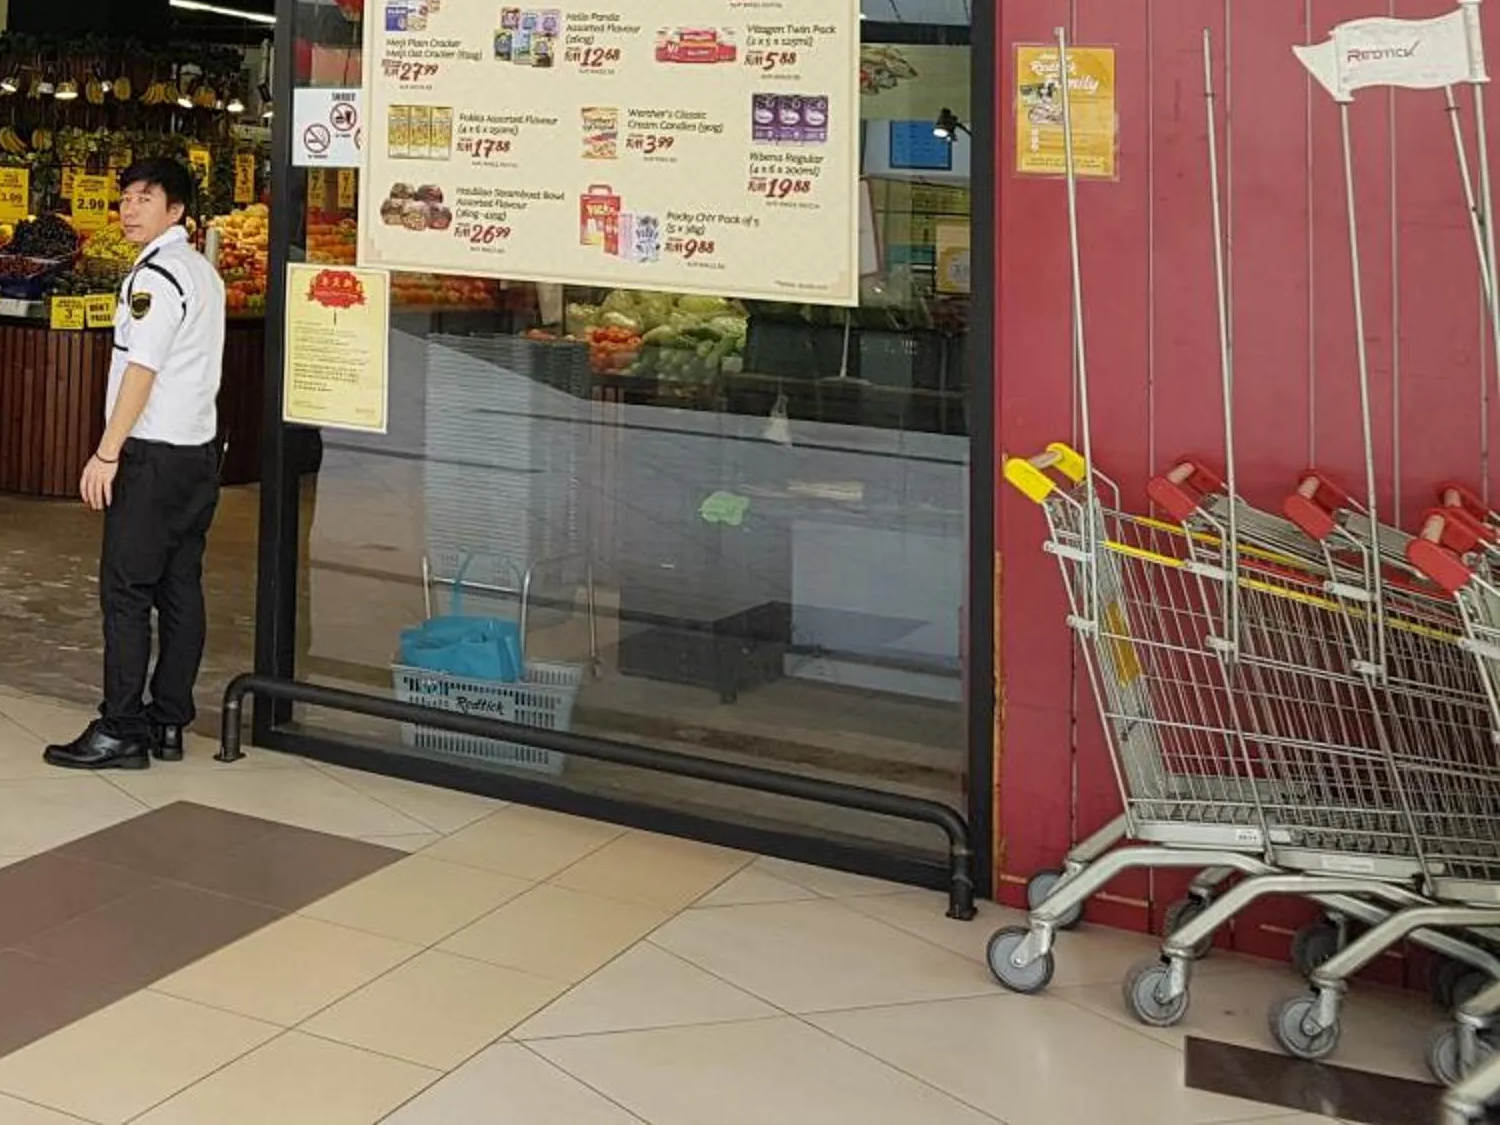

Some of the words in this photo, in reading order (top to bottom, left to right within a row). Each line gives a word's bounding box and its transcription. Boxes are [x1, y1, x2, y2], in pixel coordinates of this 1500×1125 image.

[786, 25, 811, 34] Twin
[813, 25, 837, 34] Pack
[1347, 39, 1422, 63] REDTICK
[486, 113, 524, 124] Assorted
[628, 107, 673, 119] Werther's
[675, 109, 708, 120] Classic
[627, 120, 658, 130] Cream
[659, 121, 696, 132] Candies
[543, 190, 565, 201] Bowl
[666, 210, 697, 223] Pocky
[718, 213, 741, 224] Pack
[455, 695, 505, 716] Redtick
